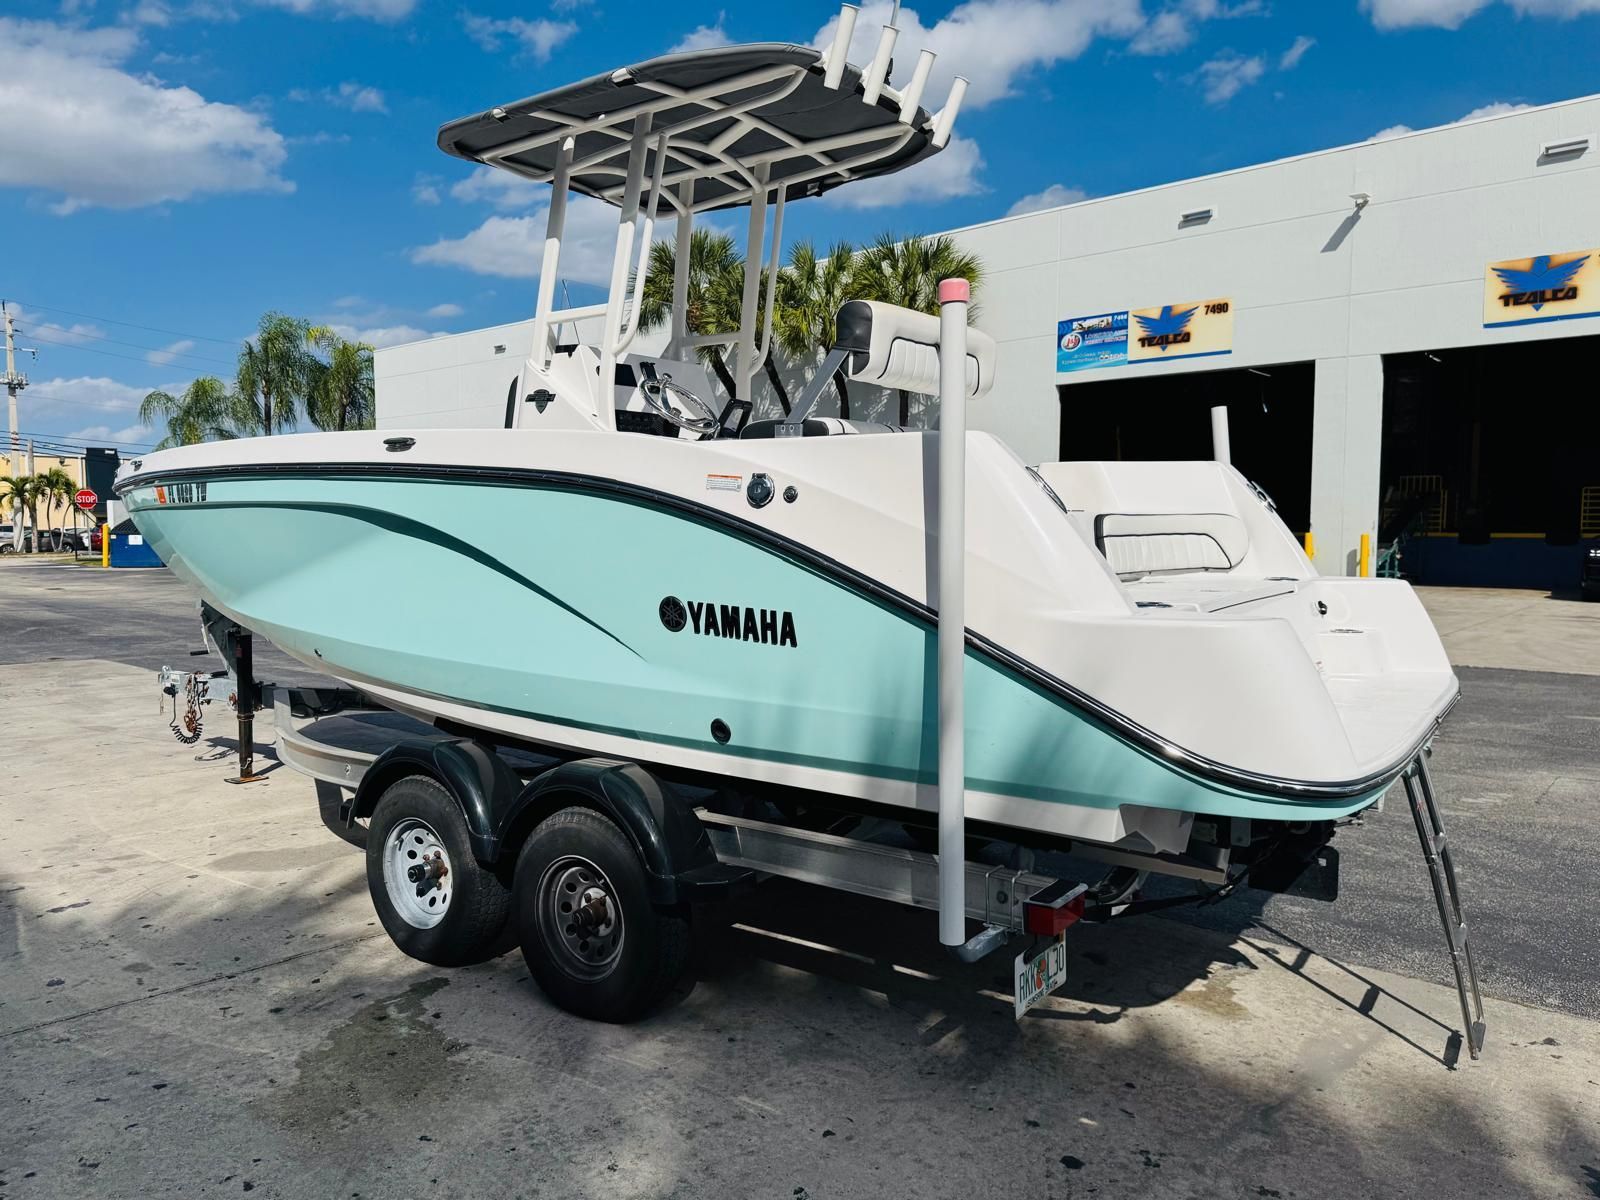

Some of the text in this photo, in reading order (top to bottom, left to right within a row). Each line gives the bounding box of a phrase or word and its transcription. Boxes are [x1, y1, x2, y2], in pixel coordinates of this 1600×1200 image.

[1204, 302, 1229, 315] 7490
[77, 495, 96, 503] STOP
[687, 600, 798, 648] YAMAHA
